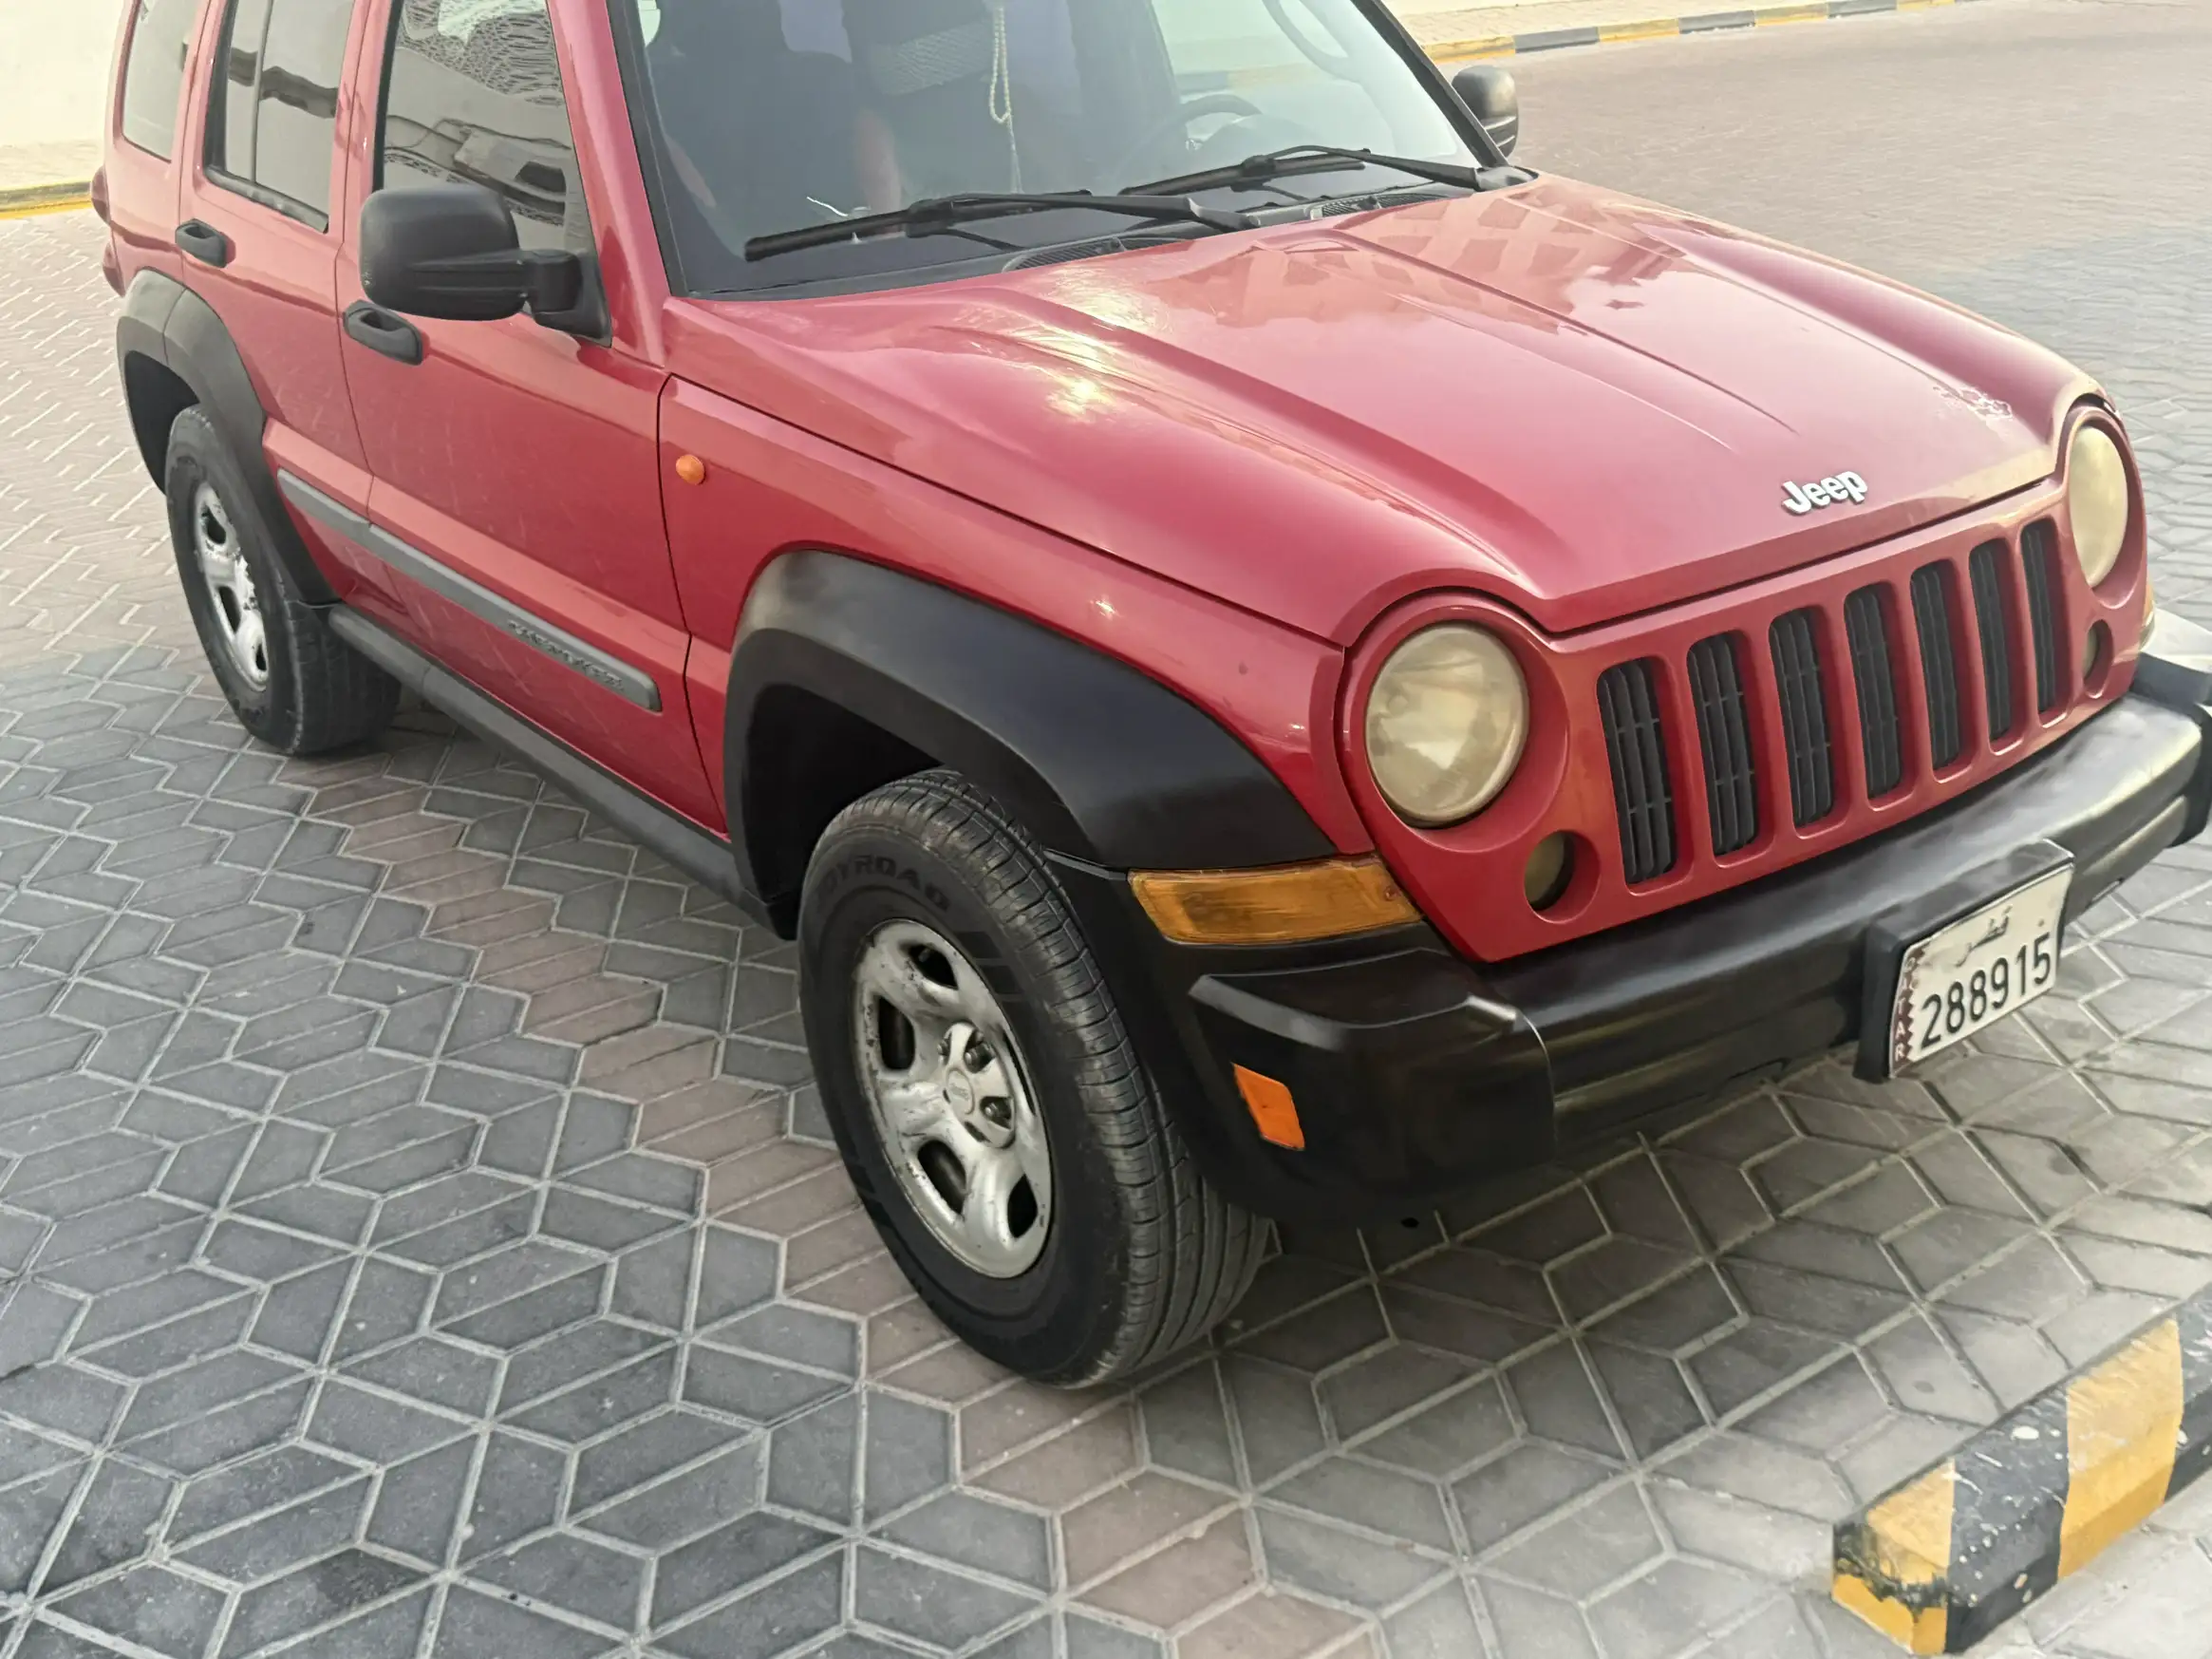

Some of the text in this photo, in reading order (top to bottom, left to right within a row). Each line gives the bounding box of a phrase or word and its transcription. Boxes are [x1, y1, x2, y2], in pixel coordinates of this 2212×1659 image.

[1781, 471, 1867, 516] Jeep
[1955, 905, 2014, 968] قطر
[1921, 932, 2052, 1050] 288915
